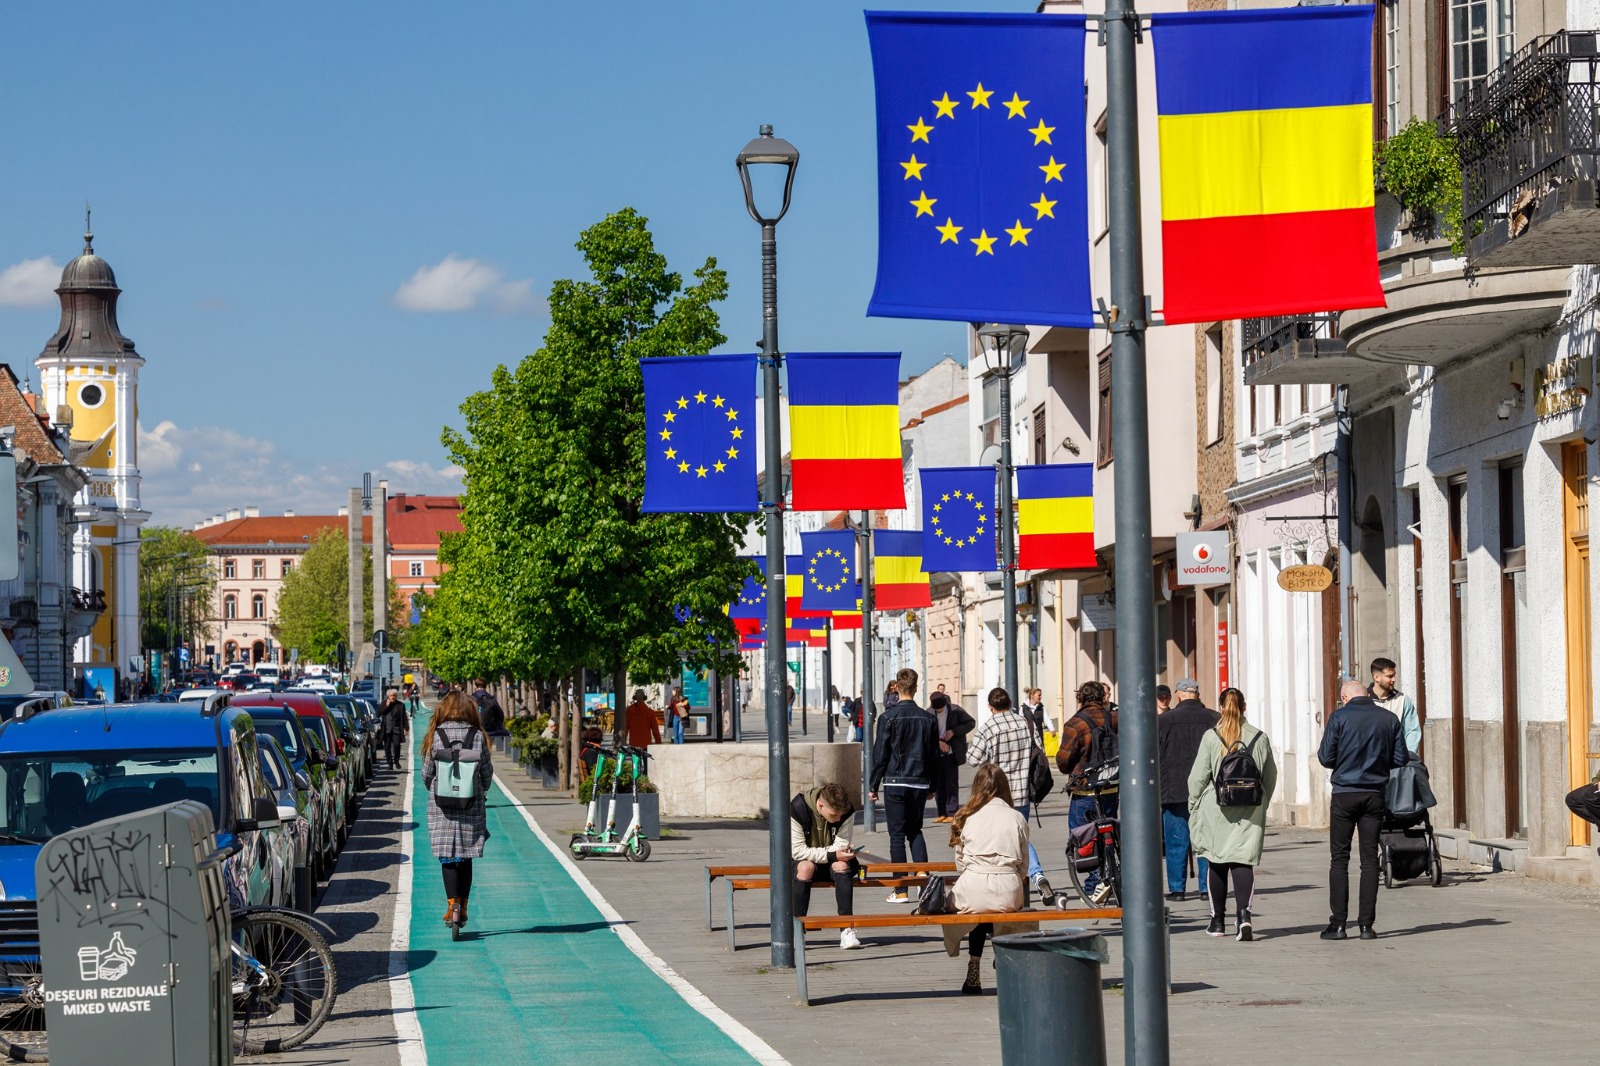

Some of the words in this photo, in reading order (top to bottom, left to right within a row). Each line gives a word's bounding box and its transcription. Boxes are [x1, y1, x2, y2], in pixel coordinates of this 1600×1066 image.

[1183, 564, 1227, 574] vodafone
[1286, 569, 1326, 579] MOKSHA
[100, 985, 168, 999] REZIDUALE
[63, 1002, 105, 1015] MIXED
[107, 1000, 151, 1013] WASTE
